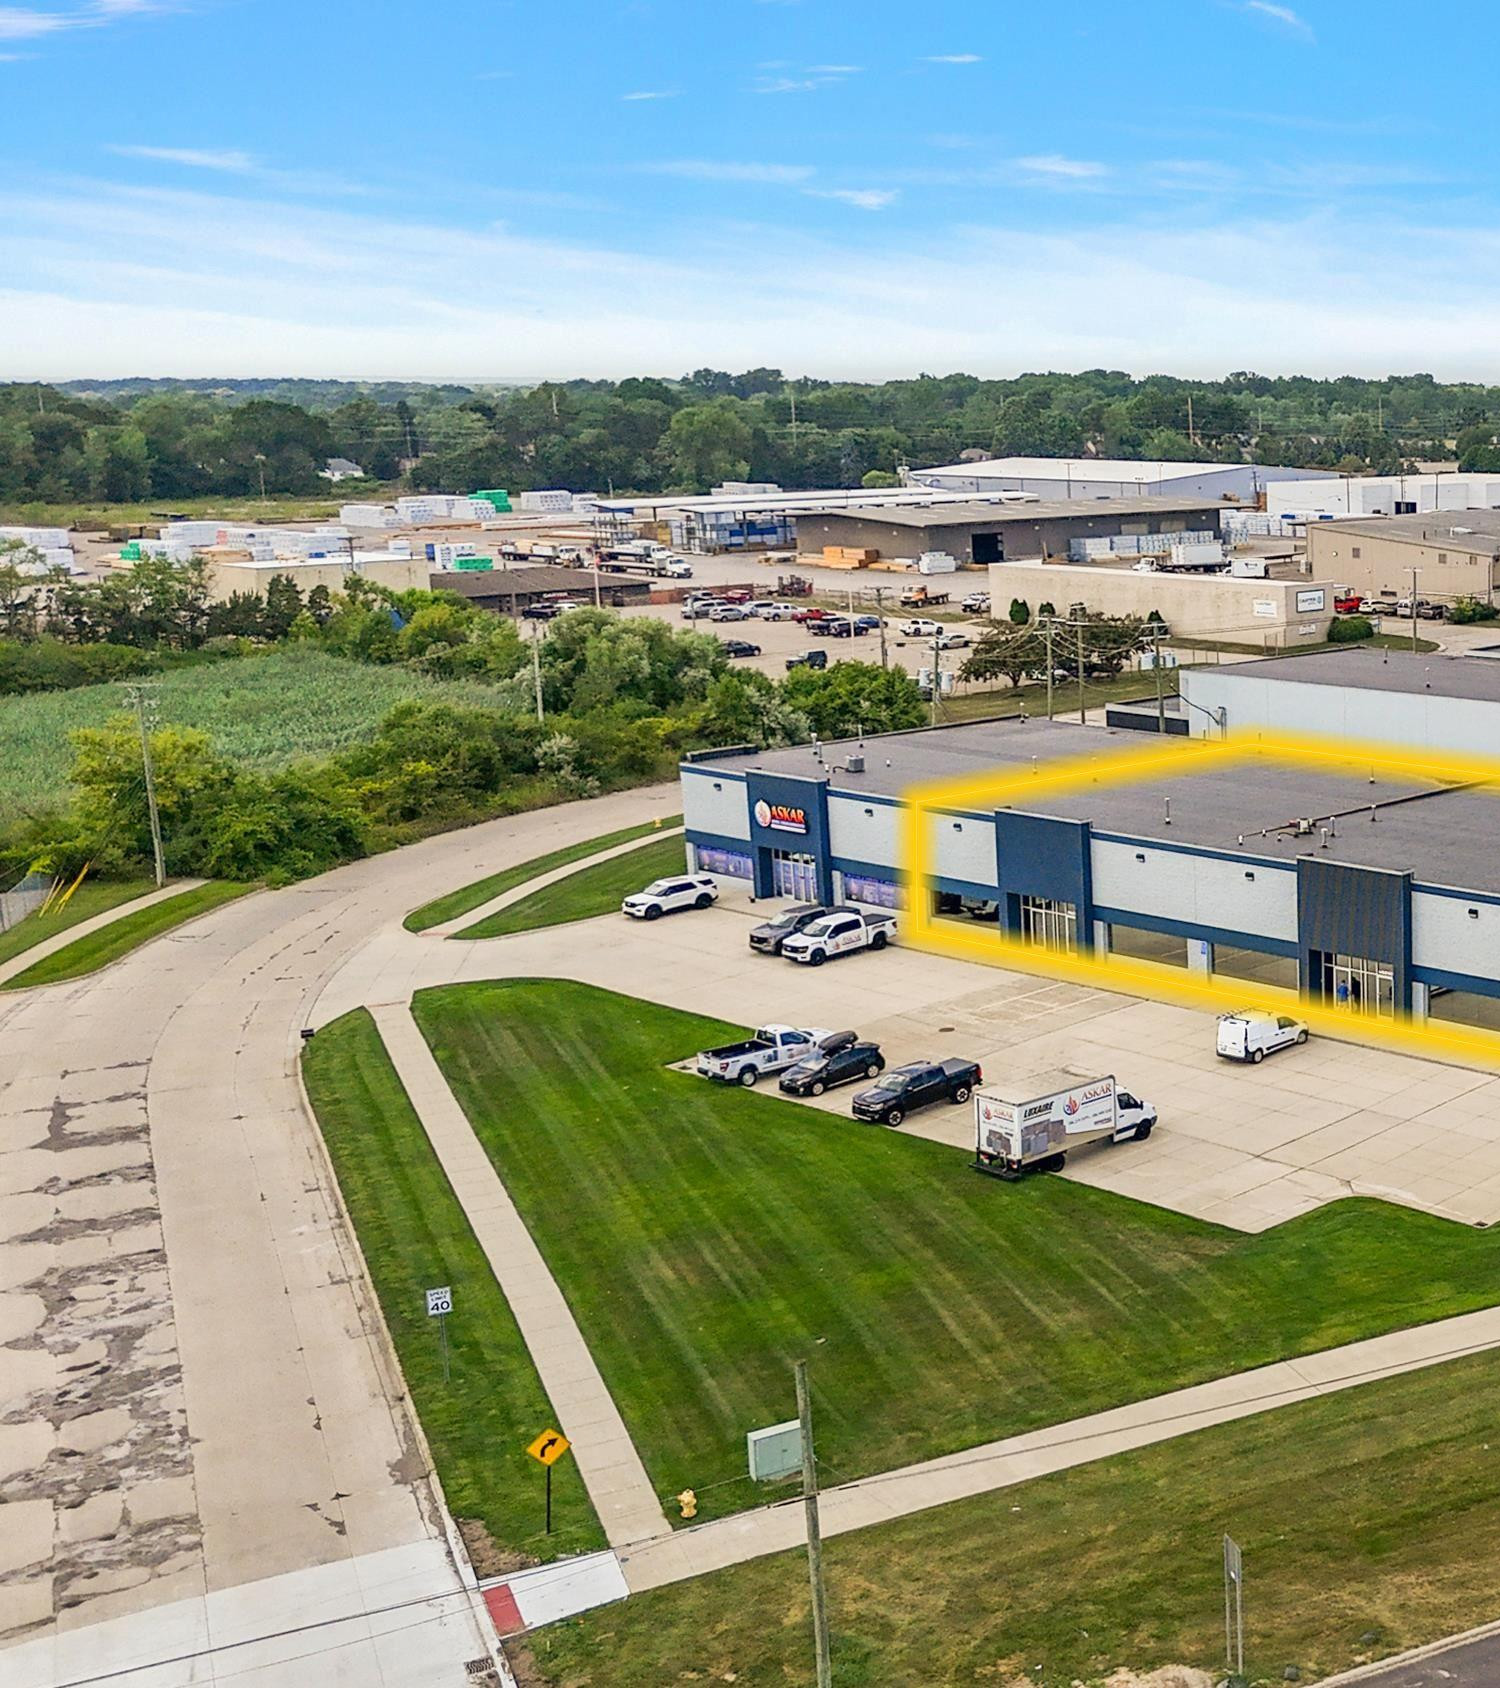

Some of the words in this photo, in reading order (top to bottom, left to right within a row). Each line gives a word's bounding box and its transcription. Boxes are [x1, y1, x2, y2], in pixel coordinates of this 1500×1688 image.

[771, 805, 805, 824] ASKAR
[1081, 1083, 1112, 1101] ASKAR
[1024, 1101, 1055, 1118] LUXAIRE
[431, 1301, 450, 1311] 40
